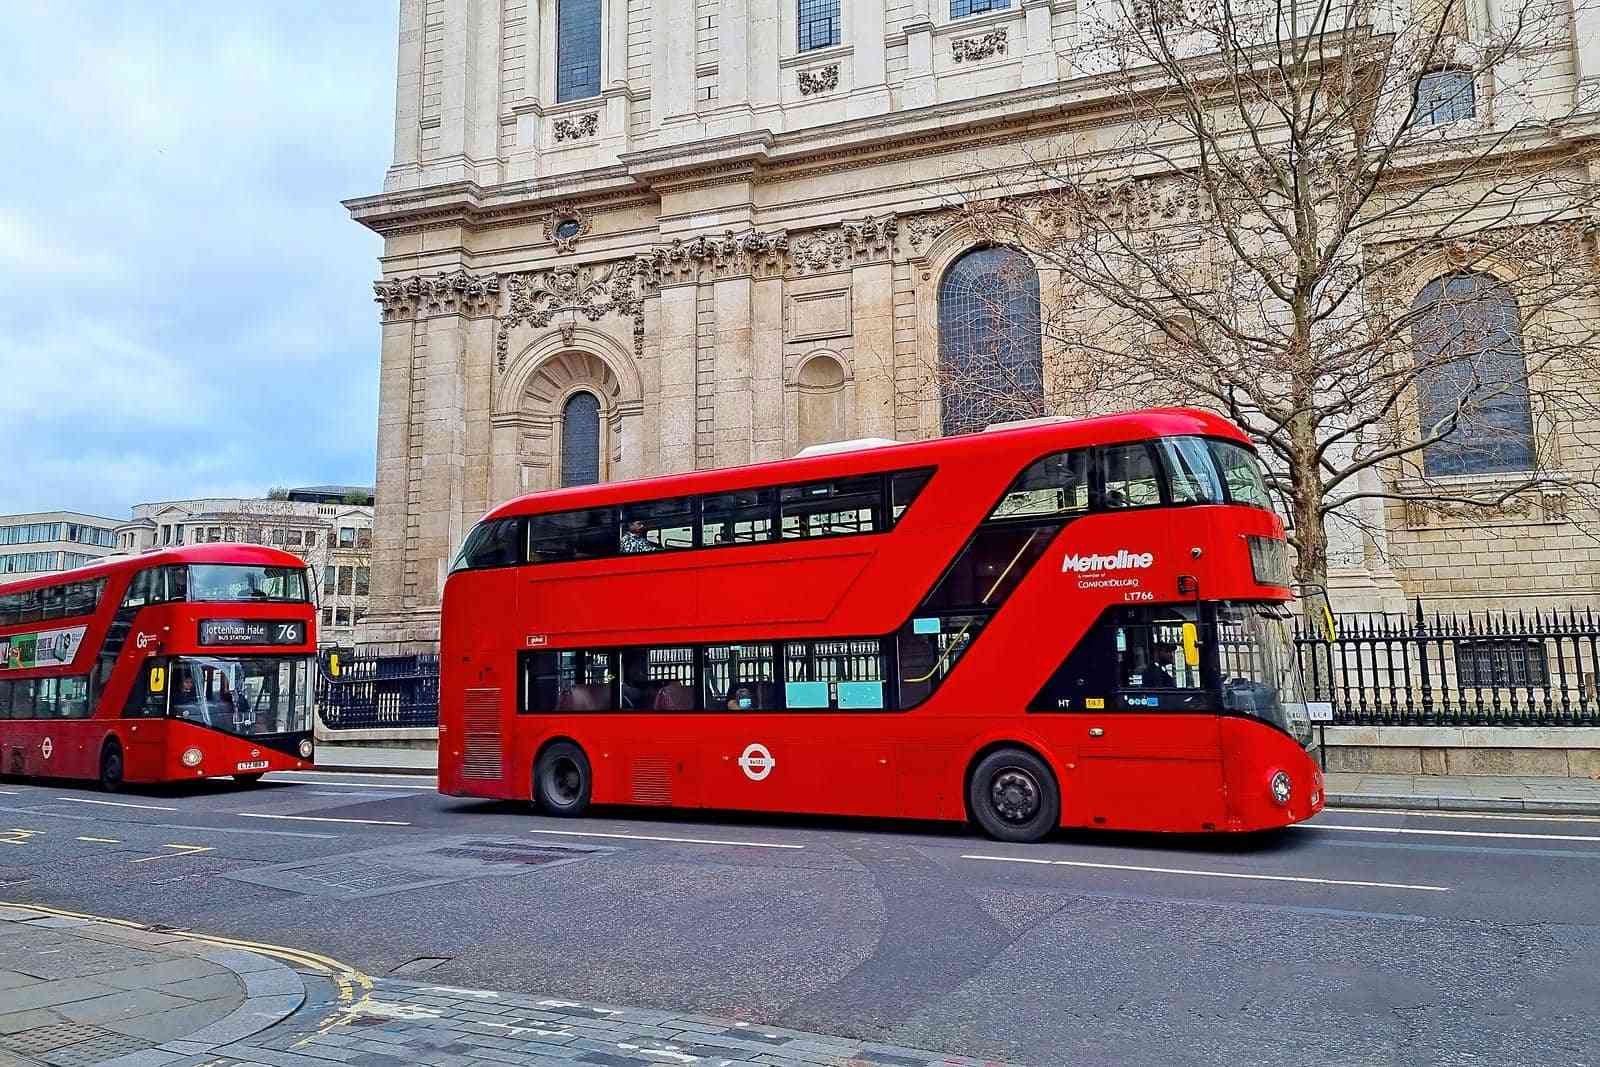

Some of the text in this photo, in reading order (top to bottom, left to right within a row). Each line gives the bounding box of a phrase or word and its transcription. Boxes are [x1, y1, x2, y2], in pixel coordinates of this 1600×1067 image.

[1062, 550, 1153, 573] Metroline
[1124, 592, 1153, 600] LT766
[206, 624, 264, 635] Tottenham Hale
[278, 624, 297, 640] 76
[1058, 699, 1070, 708] HT
